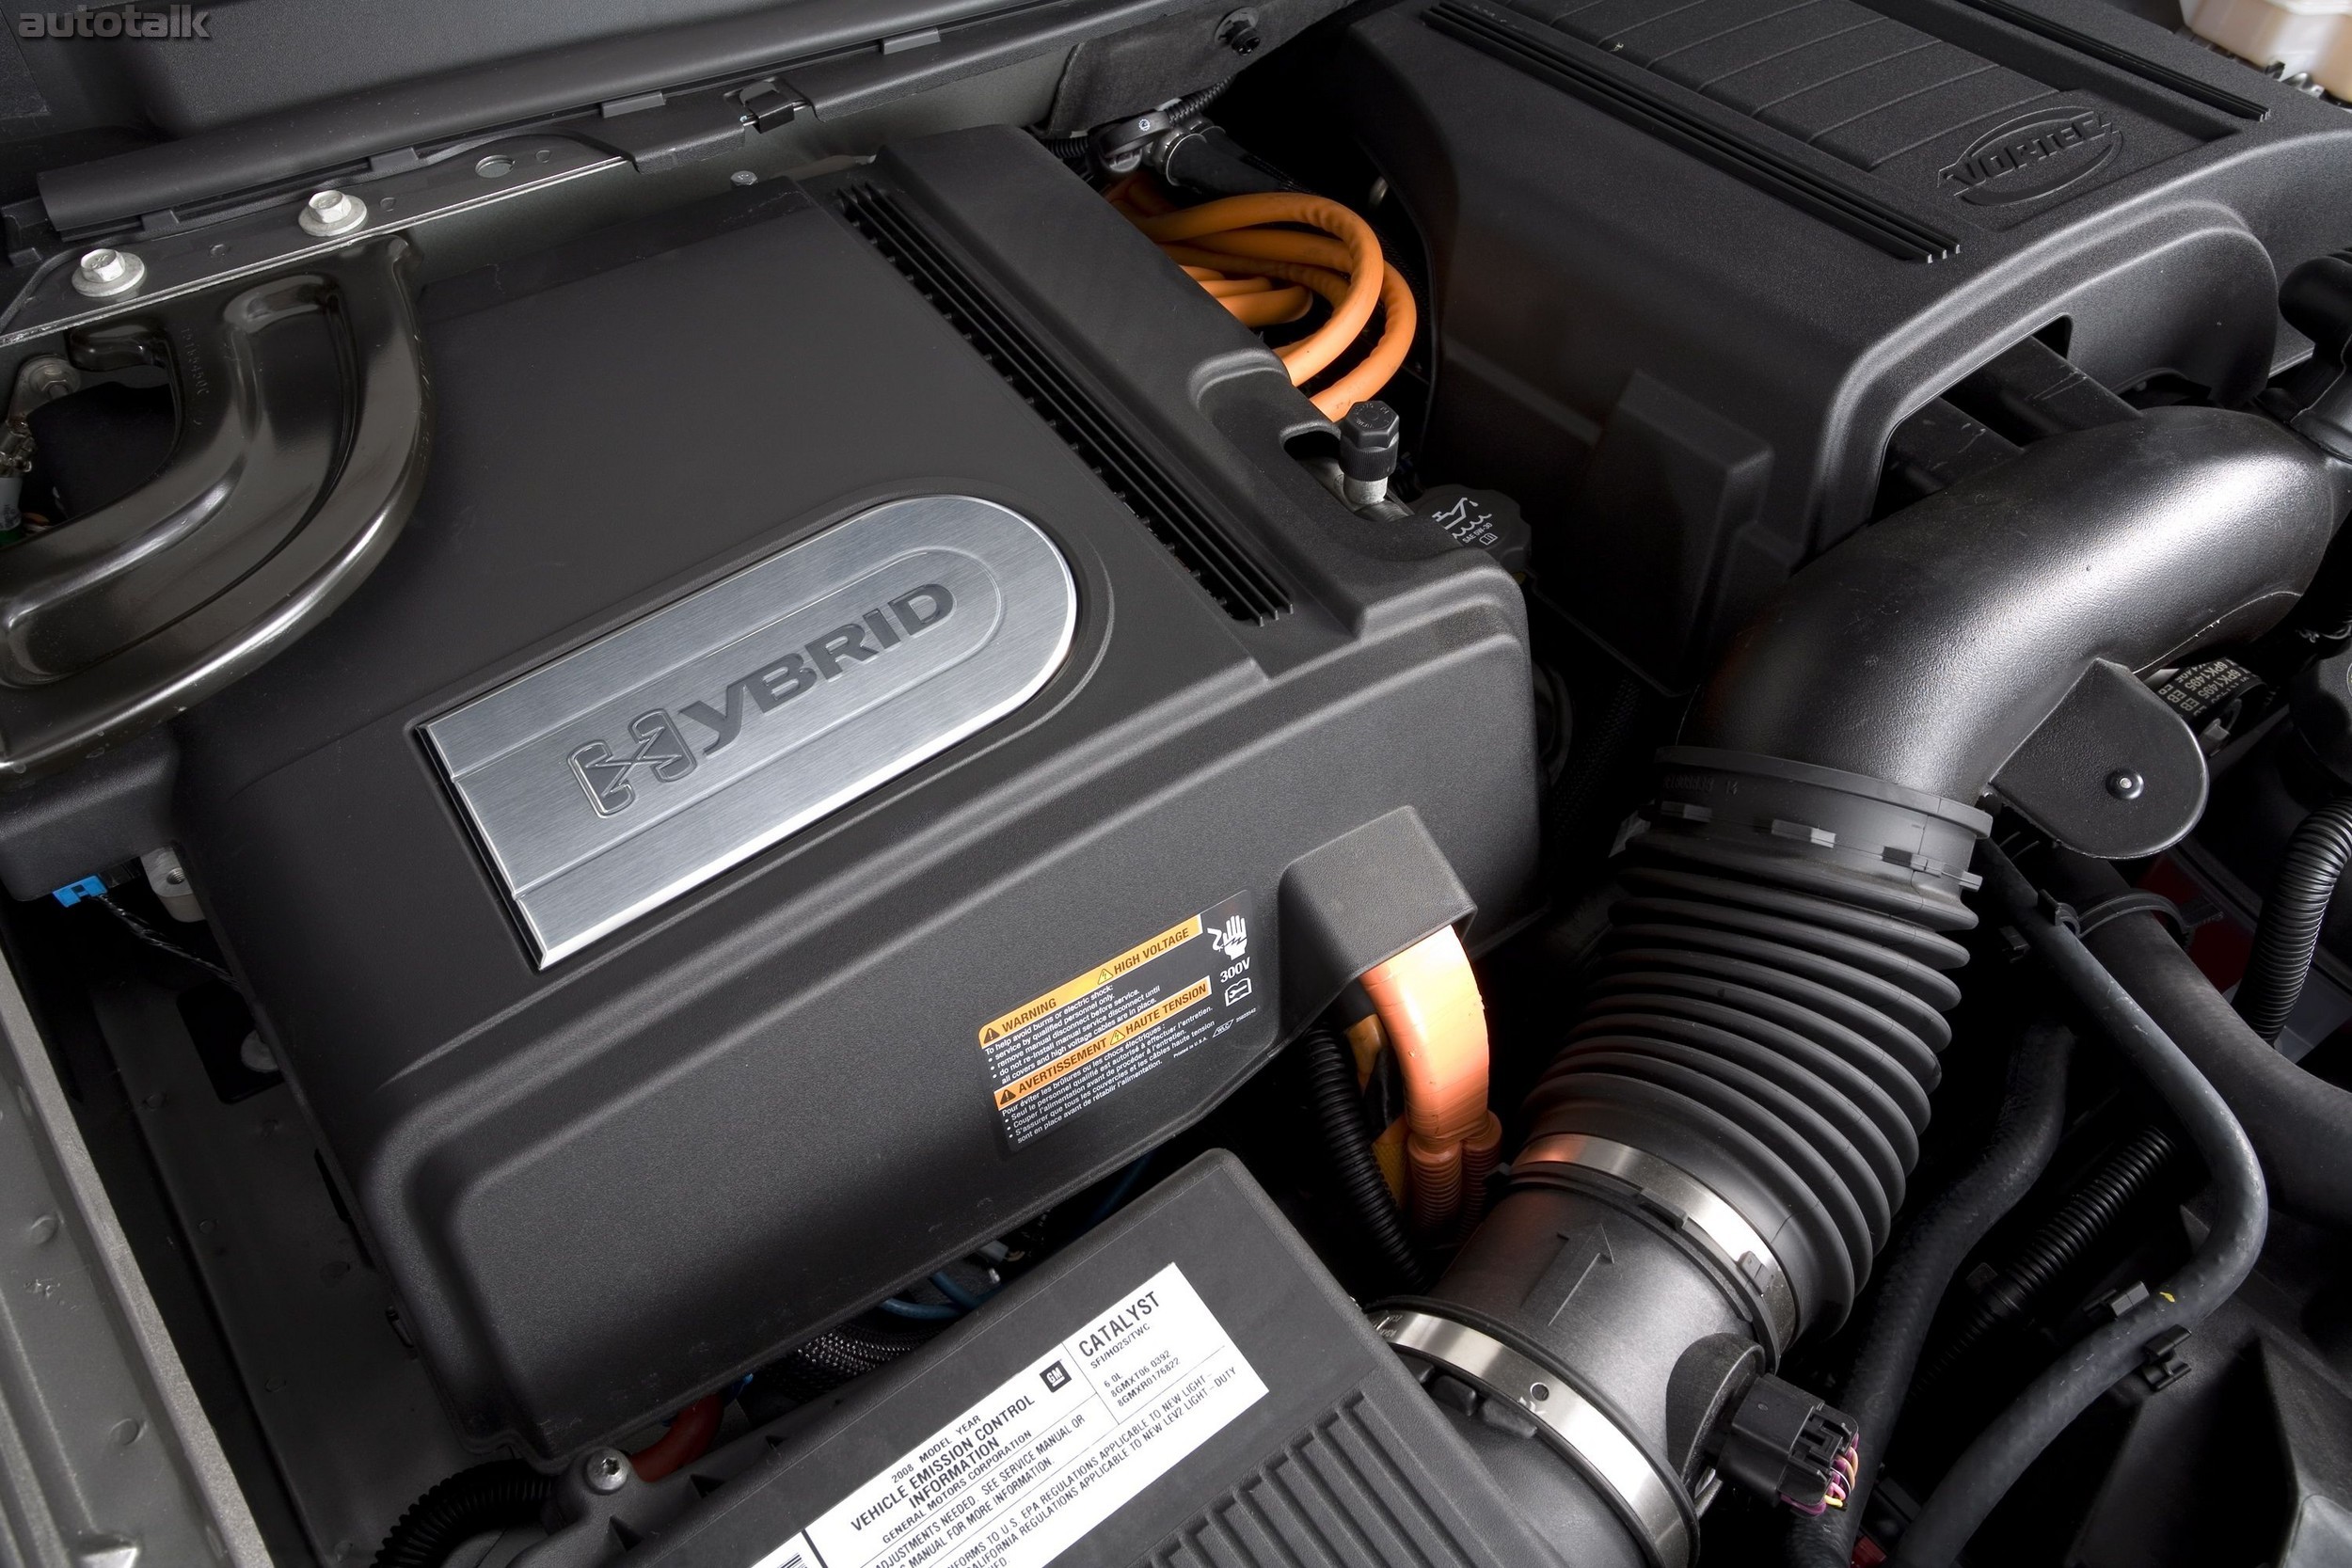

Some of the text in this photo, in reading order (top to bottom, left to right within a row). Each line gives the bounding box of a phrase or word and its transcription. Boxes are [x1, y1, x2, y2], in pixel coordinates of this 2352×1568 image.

[1462, 533, 1476, 543] SAE
[2167, 689, 2187, 704] EB
[2180, 697, 2201, 711] EB
[1114, 927, 1189, 974] HIGH VOLTAGE
[1220, 957, 1249, 983] 300V
[995, 1038, 1011, 1051] help
[1013, 1026, 1032, 1041] avoid
[1033, 1017, 1054, 1031] burns
[1064, 997, 1089, 1014] electric
[1090, 985, 1113, 1000] shock:
[995, 993, 1115, 1060] service by qualified personnel only.
[997, 990, 1139, 1068] remove manual disconnect before service.
[1000, 985, 1160, 1076] do not re-install manual service disconnect until
[1002, 998, 1057, 1032] WARNING
[1002, 1075, 1010, 1085] all
[1012, 1063, 1035, 1079] covers
[1037, 1053, 1050, 1066] and
[1051, 1046, 1066, 1058] high
[1068, 1032, 1092, 1049] voltage
[1093, 1020, 1116, 1035] cables
[1117, 1013, 1128, 1022] are
[1136, 998, 1158, 1012] place.
[1126, 984, 1206, 1035] HAUTE TENSION
[1002, 1104, 1018, 1117] Pour
[1020, 1093, 1040, 1107] éviter
[1041, 1086, 1052, 1095] les
[1053, 1070, 1081, 1089] brûlures
[1092, 1058, 1103, 1068] les
[1104, 1047, 1124, 1061] chocs
[1125, 1026, 1161, 1049] électriques
[1011, 1107, 1027, 1120] Seul
[1038, 1083, 1072, 1107] personnel
[1073, 1069, 1098, 1086] qualifié
[1100, 1062, 1111, 1071] est
[1112, 1045, 1139, 1065] autorisé
[1147, 1025, 1176, 1045] effectuer
[1178, 1006, 1213, 1028] l'entretien.
[1013, 1111, 1038, 1128] Couper
[1040, 1085, 1085, 1114] l'alimentation
[1087, 1073, 1105, 1087] avant
[1106, 1069, 1115, 1077] de
[1116, 1052, 1145, 1072] procéder
[1152, 1030, 1186, 1051] l'entretien.
[1015, 1021, 1215, 1135] S'assurer que tous les couvercles et les câbles haute tension
[1018, 1131, 1033, 1143] sont
[1034, 1126, 1042, 1134] en
[1044, 1116, 1062, 1130] place
[1064, 1103, 1082, 1117] avant
[1093, 1085, 1116, 1101] rétablir
[1118, 1060, 1162, 1087] l'alimentation.
[1019, 1037, 1106, 1093] AVERTISSEMENT
[1079, 1291, 1159, 1356] CATALYST
[850, 1396, 1035, 1530] VEHICLE EMISSION CONTROL
[882, 1431, 1032, 1544] GENERAL MOTORS CORPORATION
[892, 1416, 981, 1483] 2008 MODEL YEAR
[909, 1436, 999, 1509] INFORMATION
[940, 1496, 978, 1527] NEEDED.
[981, 1478, 999, 1495] SEE
[999, 1450, 1036, 1481] SERVICE
[1036, 1426, 1072, 1455] MANUAL
[1072, 1415, 1085, 1428] OR
[987, 1531, 1000, 1544] TO
[1000, 1518, 1018, 1534] U.S.
[1021, 1502, 1040, 1519] EPA
[1040, 1457, 1098, 1504] REGULATIONS
[1100, 1419, 1148, 1460] APPLICABLE
[1149, 1410, 1161, 1421] TO
[1162, 1394, 1181, 1412] NEW
[1019, 1487, 1078, 1536] REGULATIONS
[1079, 1449, 1128, 1490] APPLICABLE
[1130, 1439, 1142, 1450] TO
[1142, 1423, 1162, 1441] NEW
[1163, 1407, 1183, 1425] LEV2
[909, 1457, 1052, 1568] MANUAL FOR MORE INFORMATION.
